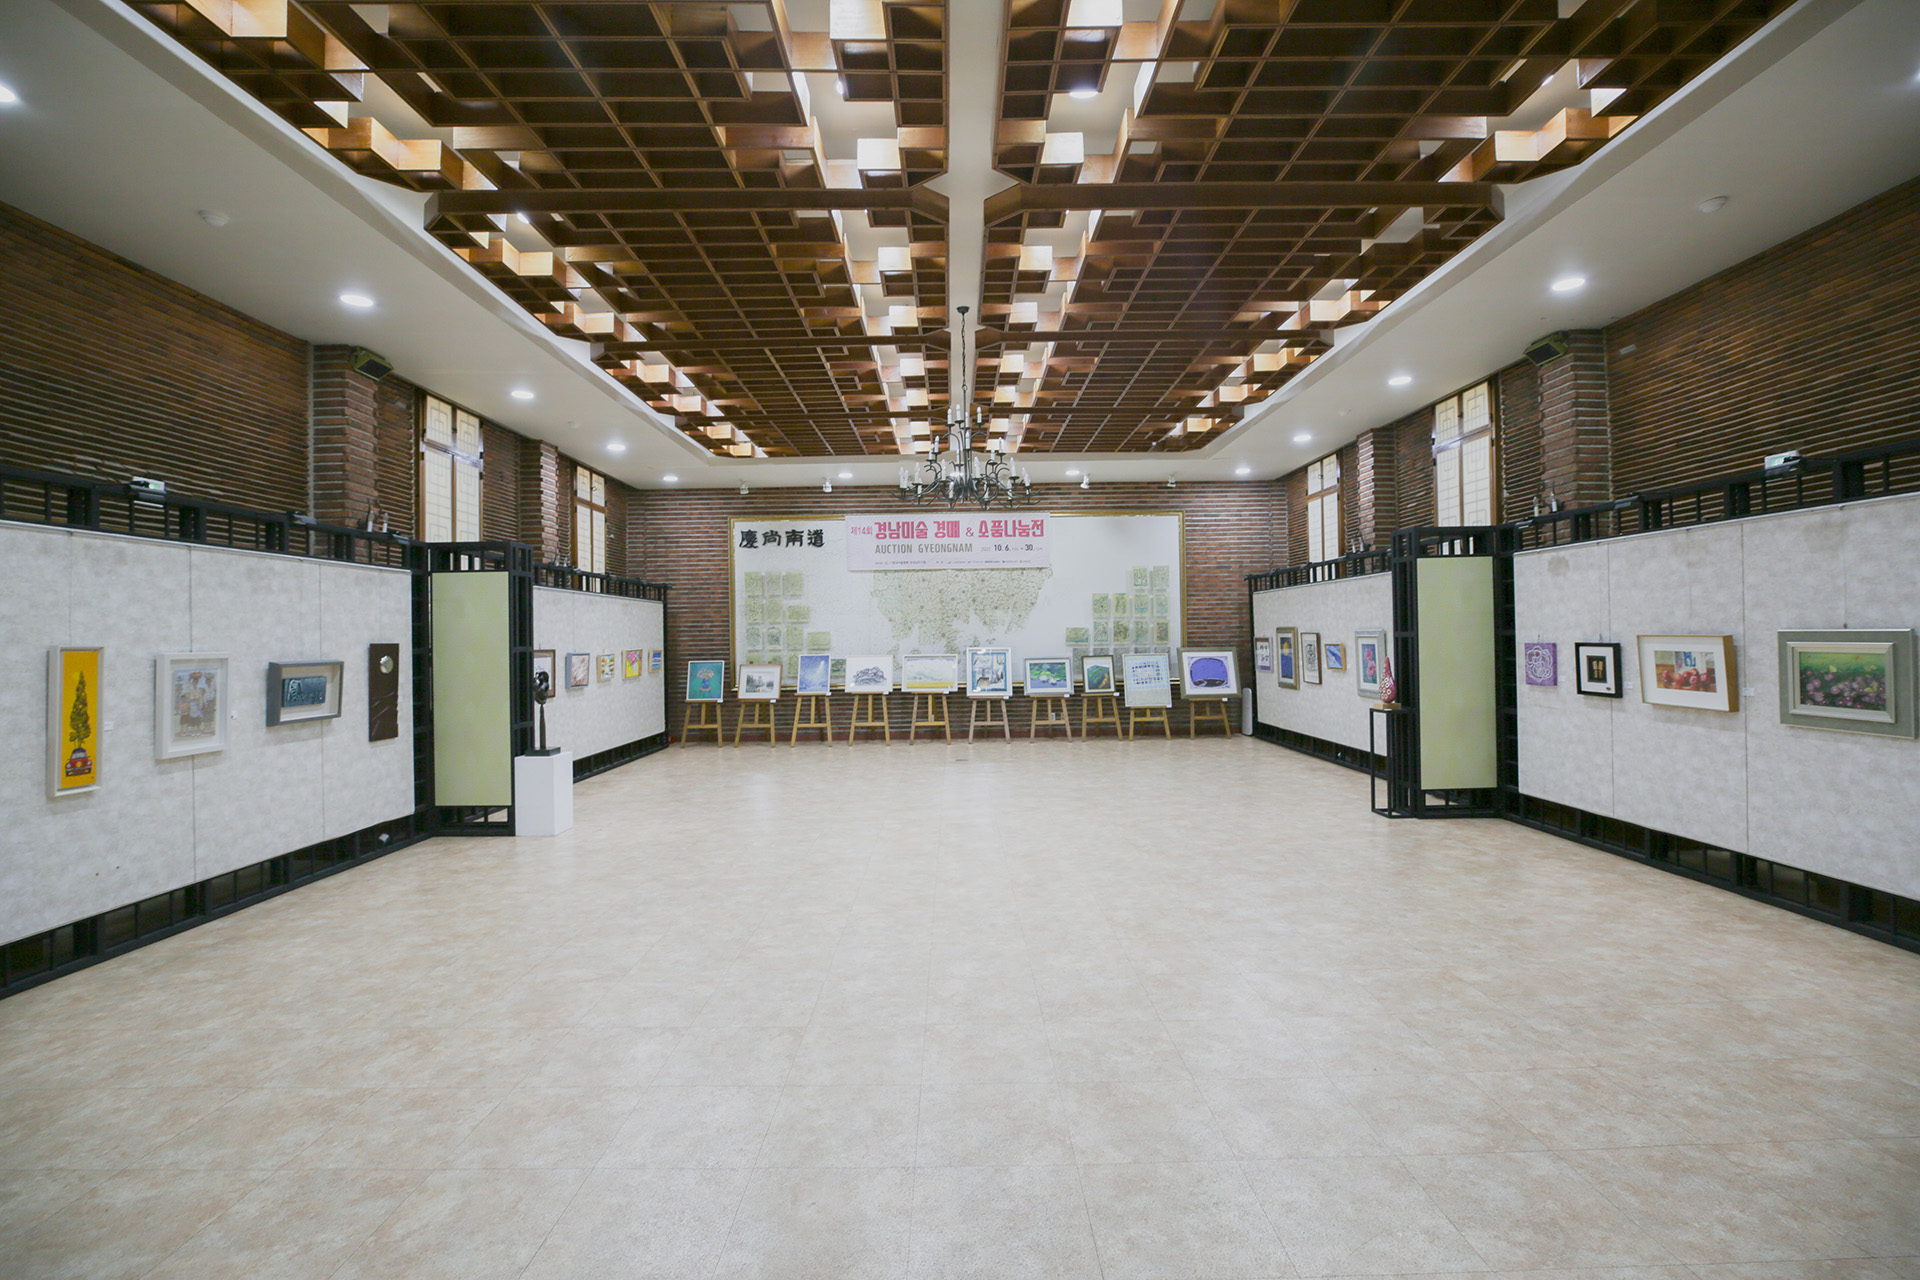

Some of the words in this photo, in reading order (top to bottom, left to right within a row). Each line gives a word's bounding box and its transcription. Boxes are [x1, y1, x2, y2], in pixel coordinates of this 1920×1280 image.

[850, 525, 873, 536] 제14회
[874, 520, 929, 540] 경남미술
[933, 520, 960, 539] 경매
[965, 526, 975, 538] &
[978, 519, 1044, 538] 소품나눔전
[875, 543, 913, 554] AUCTION
[918, 543, 973, 553] GYEONGNAM
